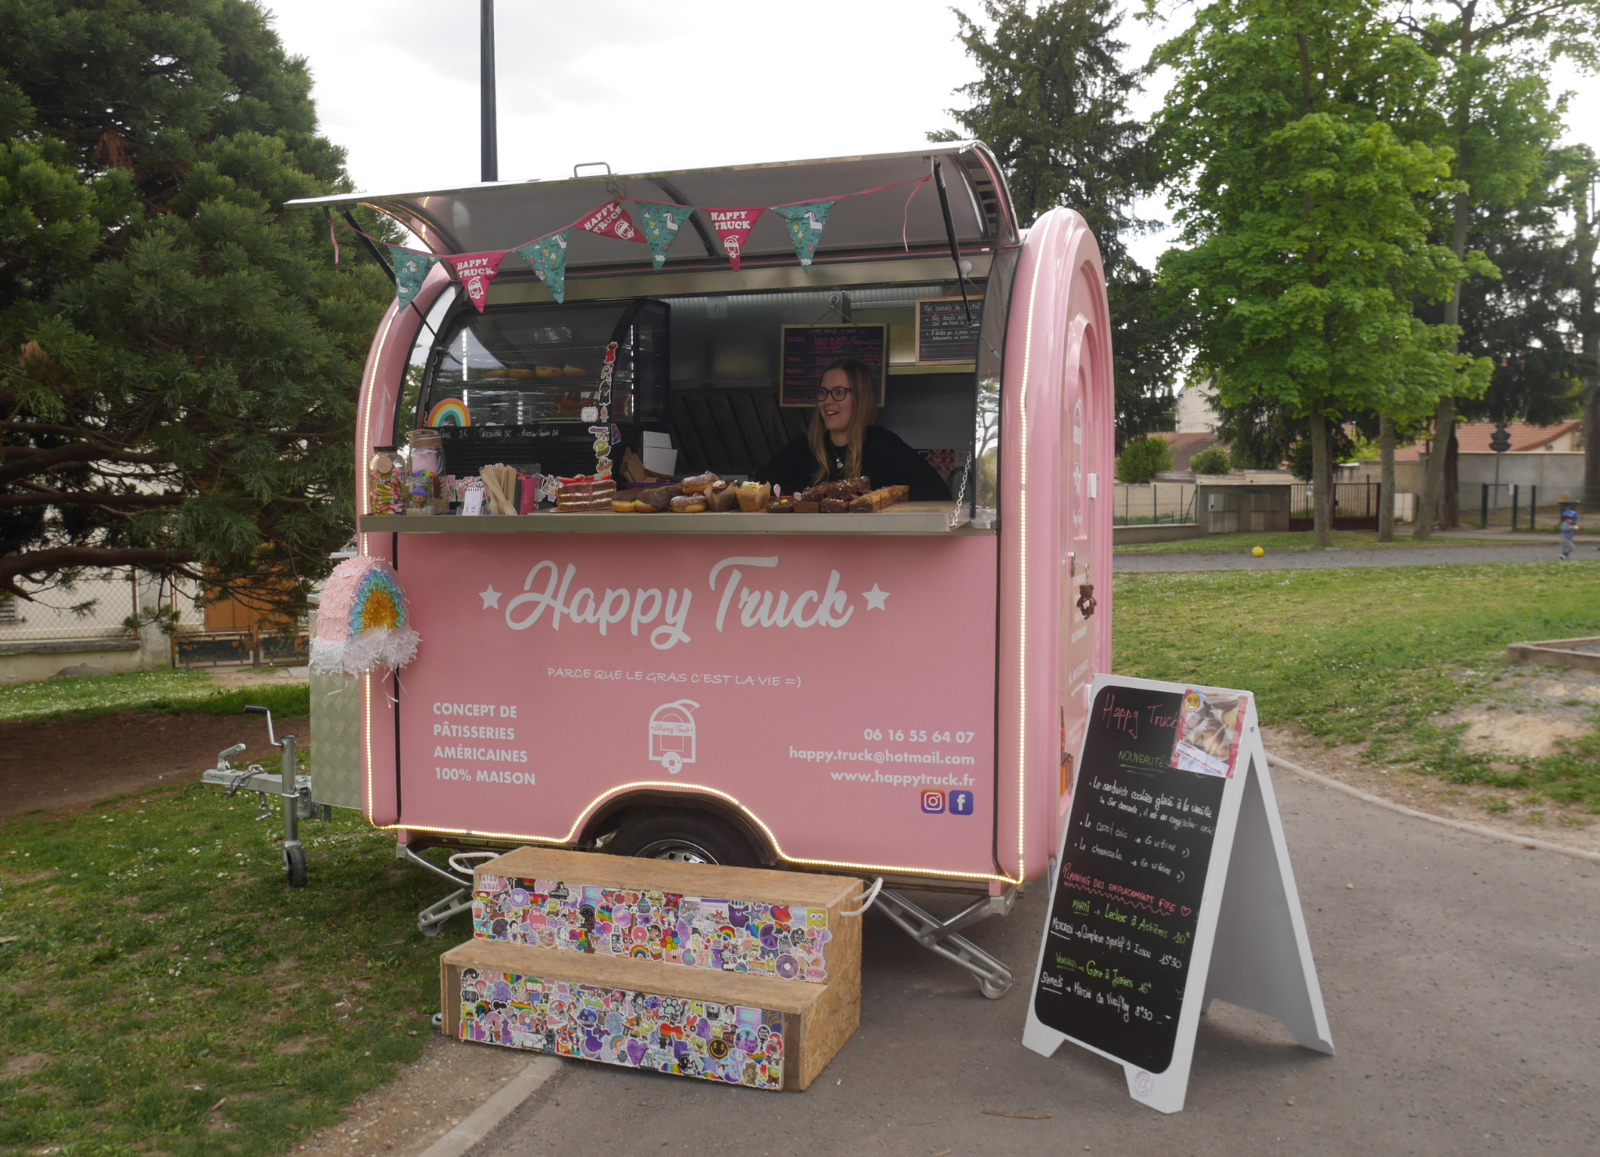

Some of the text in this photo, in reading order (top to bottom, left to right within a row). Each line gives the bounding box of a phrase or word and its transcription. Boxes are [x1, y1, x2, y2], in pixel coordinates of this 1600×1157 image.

[584, 202, 615, 231] HAPPY
[592, 205, 623, 234] TRUCK
[710, 211, 748, 221] HAPPY
[714, 221, 751, 230] TRUCK
[456, 258, 489, 271] HAPPY
[458, 267, 494, 279] TRUCK
[505, 555, 854, 650] Happy Truck
[547, 667, 591, 678] PARCE
[594, 670, 623, 680] QUE
[626, 671, 643, 681] LE
[646, 672, 688, 683] GRAS
[691, 673, 733, 684] C'EST
[735, 675, 755, 686] LA
[758, 676, 781, 687] VIE
[433, 702, 517, 718] CONCEPT DE
[1102, 694, 1139, 740] Happy
[1147, 704, 1179, 729] Truck
[433, 721, 515, 740] PÂTISSERIES
[863, 728, 975, 744] 06 16 55 64 07
[433, 743, 528, 763] AMÉRICAINES
[789, 745, 975, 765] happy.truck@hotmail.com
[435, 767, 536, 786] 100% MAISON
[830, 770, 976, 788] www.happytruck.fr
[1093, 775, 1101, 789] Le
[1102, 779, 1129, 797] sandwich
[1131, 788, 1153, 804] cookies
[1093, 878, 1105, 890] DES
[526, 982, 543, 992] BIG
[1040, 971, 1064, 988] Samedi
